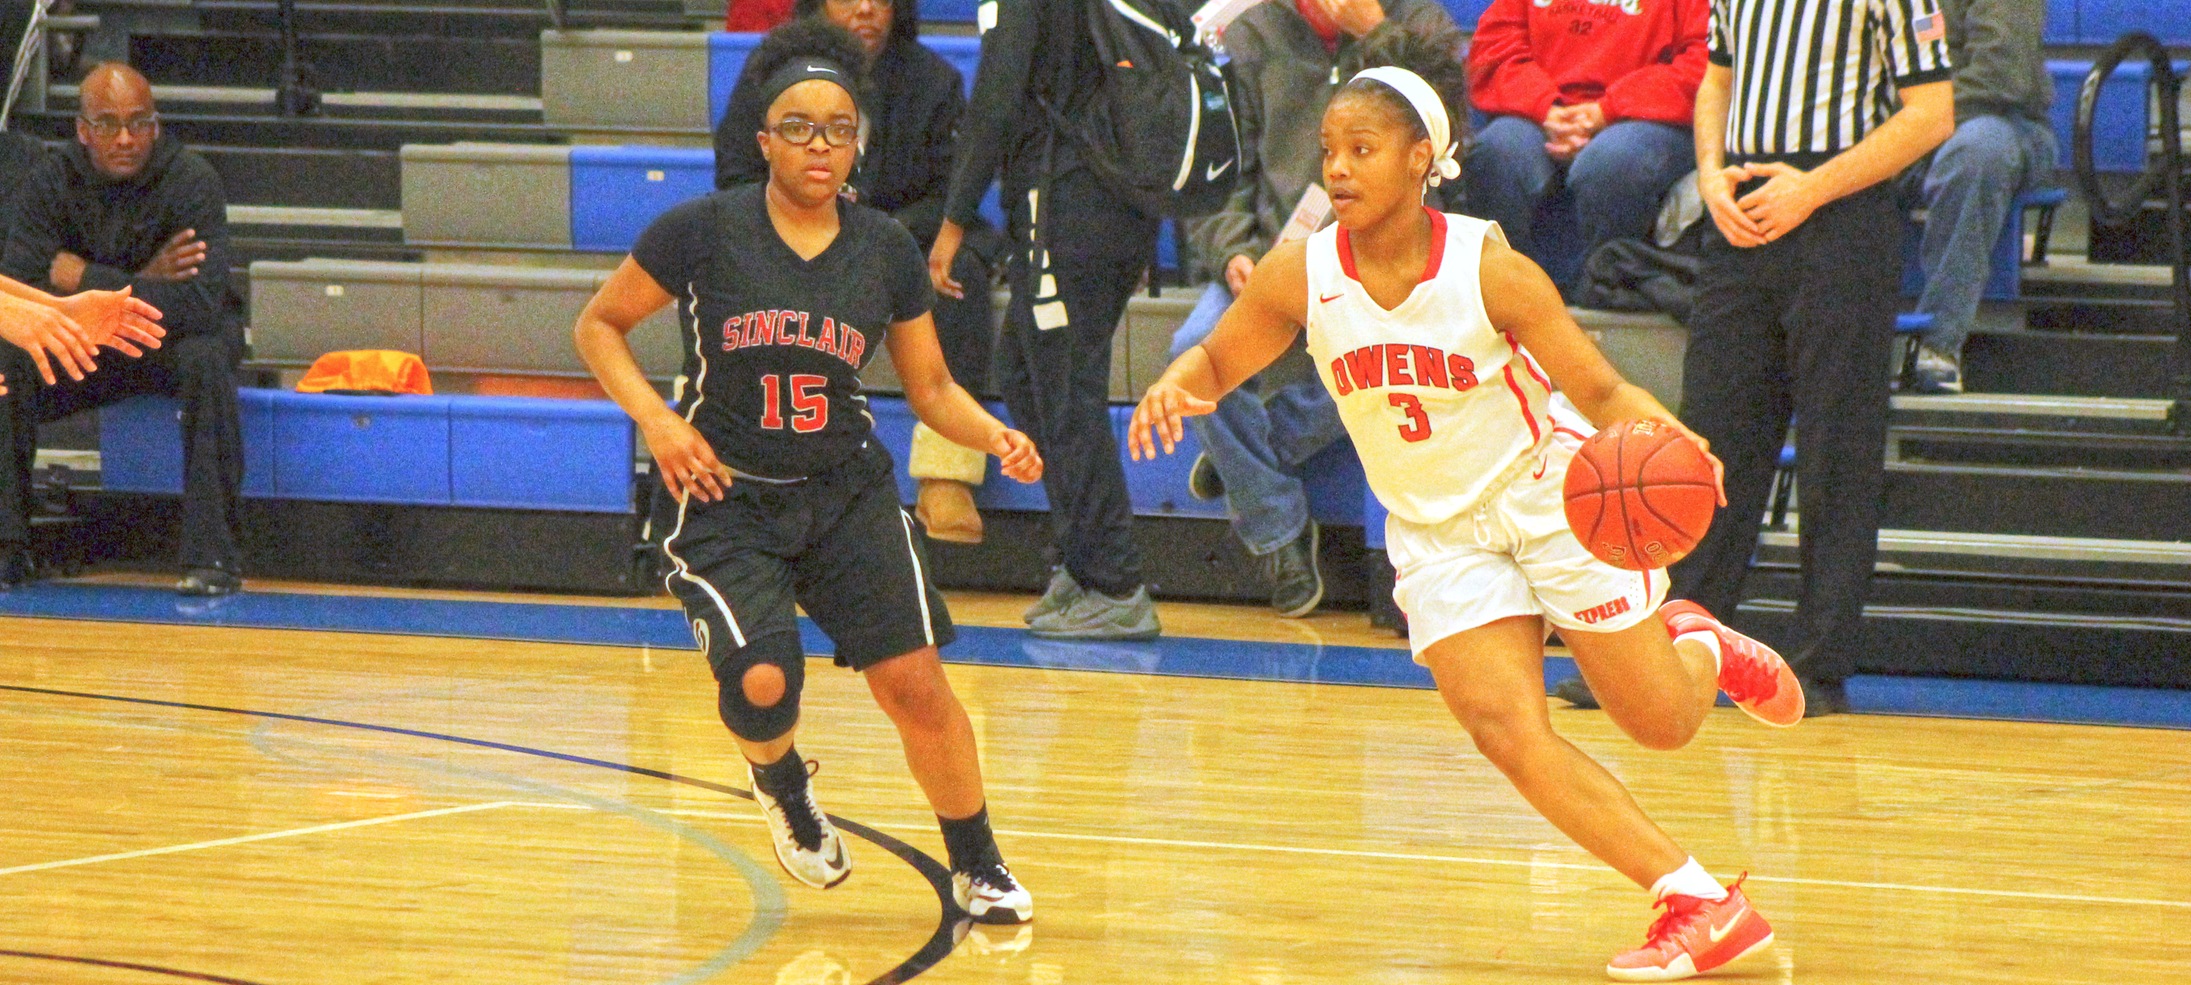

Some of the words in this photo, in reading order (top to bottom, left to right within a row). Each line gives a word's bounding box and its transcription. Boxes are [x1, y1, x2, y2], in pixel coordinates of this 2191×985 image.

[722, 309, 866, 370] SINCLAIR
[1331, 343, 1480, 396] OWENS
[760, 374, 829, 433] 15
[1388, 392, 1432, 442] 3
